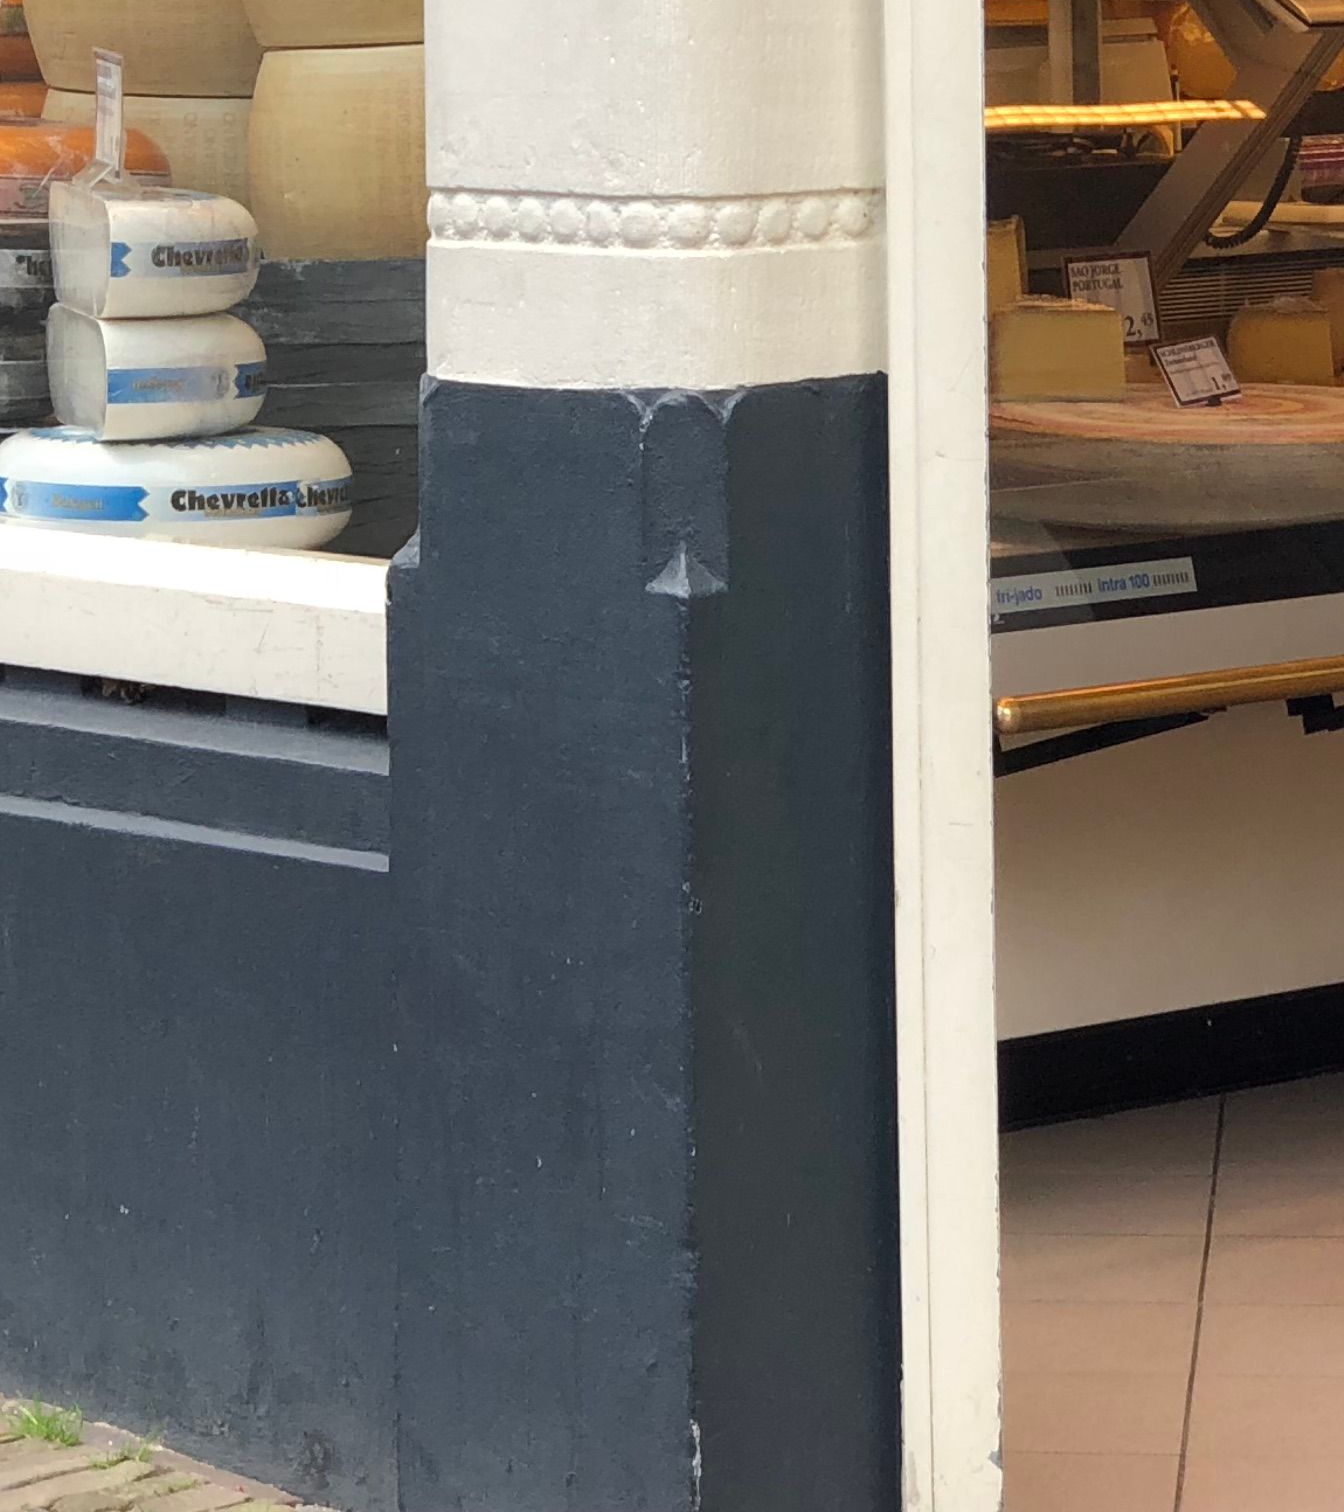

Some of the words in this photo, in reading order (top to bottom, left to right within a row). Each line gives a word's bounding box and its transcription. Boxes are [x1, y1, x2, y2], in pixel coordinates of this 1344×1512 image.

[1072, 278, 1123, 292] PORTUGAL
[996, 586, 1043, 606] fri-jado
[1097, 576, 1127, 593] intra
[1128, 573, 1150, 589] 100
